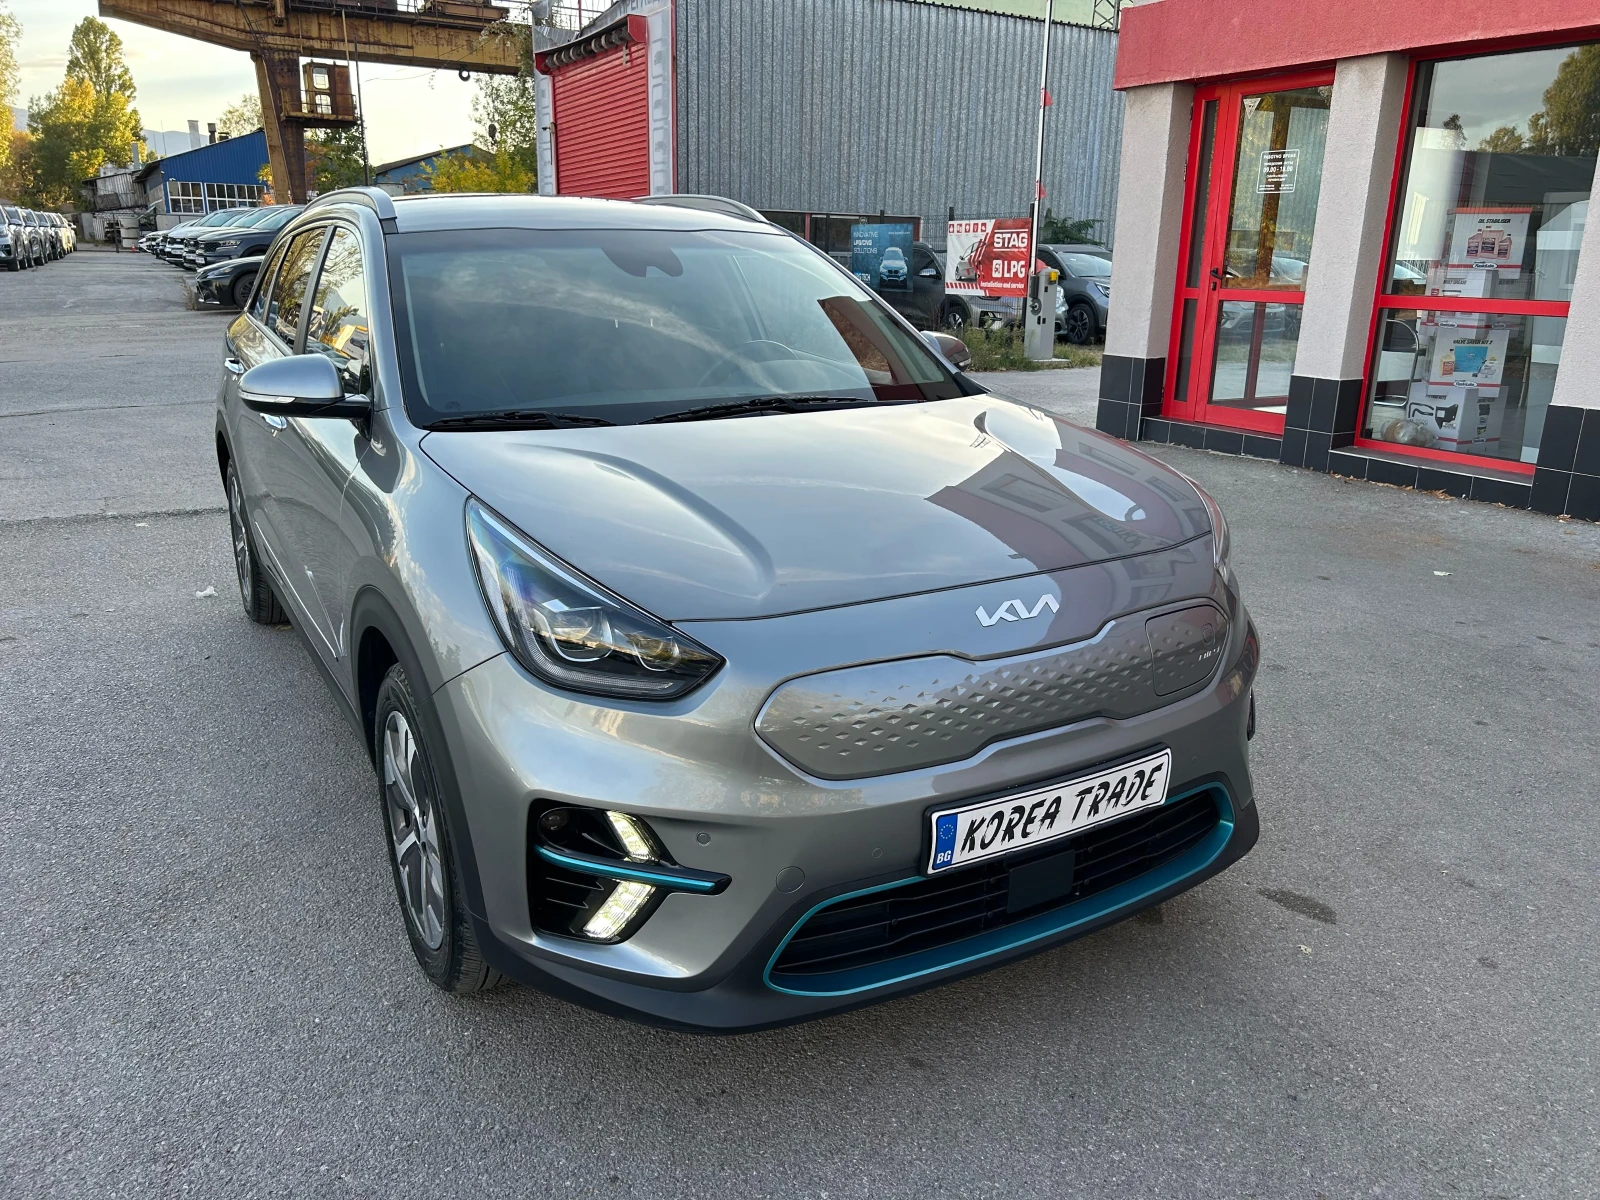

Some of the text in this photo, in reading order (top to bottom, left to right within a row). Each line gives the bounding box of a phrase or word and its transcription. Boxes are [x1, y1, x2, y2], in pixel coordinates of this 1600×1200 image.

[993, 233, 1028, 248] STAG
[1003, 260, 1026, 278] LPG
[980, 280, 1003, 288] Installation
[1002, 281, 1011, 289] and
[975, 593, 1060, 627] KIA
[936, 761, 1165, 864] BG KOREA TRADE
